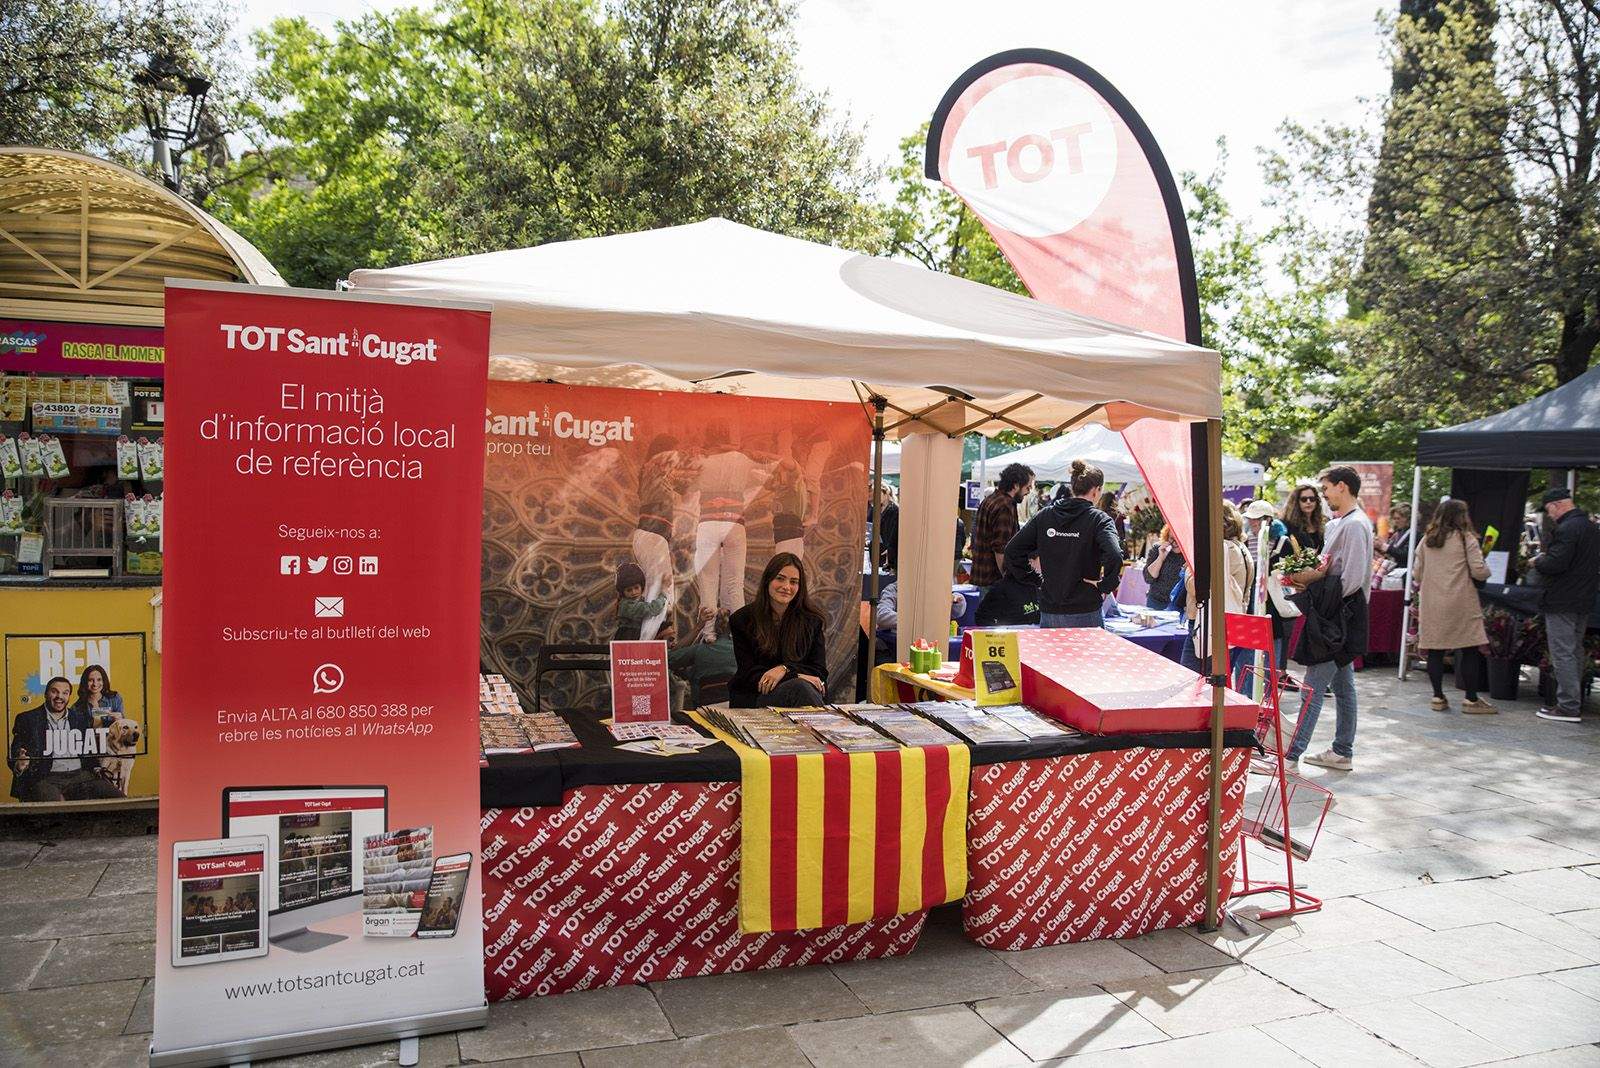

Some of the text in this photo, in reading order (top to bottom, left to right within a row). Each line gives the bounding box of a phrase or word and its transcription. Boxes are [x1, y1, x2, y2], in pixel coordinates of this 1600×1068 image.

[966, 122, 1093, 190] TOT
[63, 343, 164, 363] RASCA EL MOMEN
[220, 324, 437, 366] TOT Sant Cugat
[44, 404, 119, 414] 43802 62781
[151, 404, 157, 415] 1
[281, 383, 384, 419] El mitjà
[200, 414, 455, 449] d'informació local
[487, 441, 551, 457] prop teu
[554, 411, 634, 446] Cugat
[236, 448, 423, 480] de referència
[278, 524, 382, 541] Segueix-nos a:
[222, 625, 431, 642] Subscriu-te al butlletí del web
[217, 704, 434, 725] Envia ALTA al 680 850 388 per
[219, 722, 433, 743] rebre les notícies al WhatsApp
[43, 728, 110, 756] JUGAT
[975, 761, 1031, 821] Sant Cugat
[1008, 765, 1055, 815] TOT Sant
[1034, 760, 1103, 842] TOT Sant Cugat
[1078, 762, 1125, 810] TOT Sant
[1103, 759, 1172, 837] TOT Sant Cugat
[1152, 763, 1192, 808] TOT Sant
[489, 790, 587, 879] TOT Sant Cugat
[558, 793, 615, 850] TOT Sant
[590, 789, 684, 878] TOT Sant Cugat
[653, 792, 710, 844] TOT Sant
[978, 790, 1056, 870] TOT Sant Cugat
[1055, 787, 1127, 866] TOT Sant Cugat
[1128, 785, 1192, 866] TOT Cugat
[1178, 800, 1201, 826] TOT
[523, 821, 619, 909] TOT Sant Cugat
[621, 820, 714, 906] TOT Sant Cugat
[972, 848, 1032, 901] Sant Cugat
[1006, 816, 1077, 899] TOT Sant Cugat
[1078, 816, 1151, 894] TOT Sant Cugat
[1155, 834, 1198, 879] TOT Sant
[484, 855, 554, 923] Sant Cugat
[558, 852, 651, 939] TOT Sant Cugat
[662, 872, 719, 923] TOT Sant
[999, 874, 1053, 933] Sant Cugat
[1030, 843, 1101, 924] TOT Sant Cugat
[1073, 870, 1126, 929] Sant Cugat
[1111, 864, 1152, 911] TOT Sant
[1150, 858, 1200, 913] Sant Cugat
[1175, 881, 1198, 906] TOT
[493, 884, 587, 978] TOT Sant Cugat
[601, 870, 692, 956] TOT Sant Cugat
[656, 897, 721, 959] Sant Cugat
[553, 911, 617, 979] Sant Cugat
[224, 960, 425, 1000] www.totsantcugat.cat
